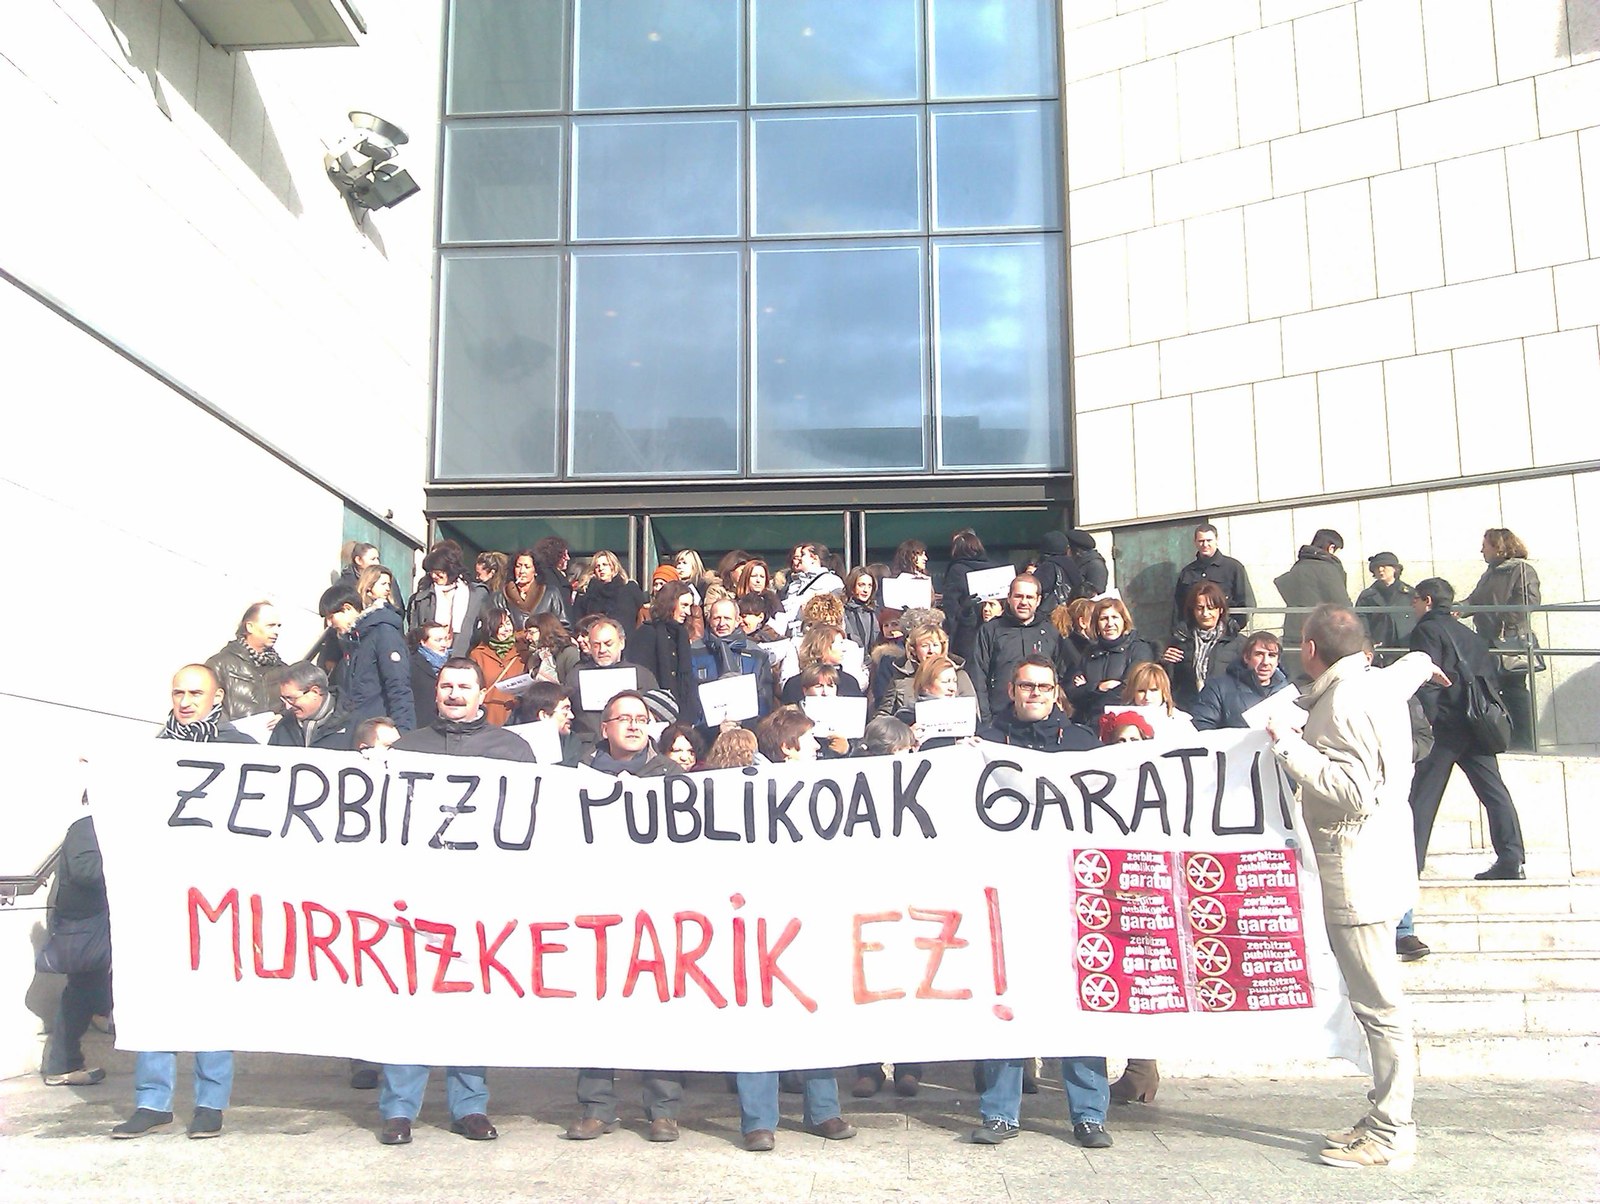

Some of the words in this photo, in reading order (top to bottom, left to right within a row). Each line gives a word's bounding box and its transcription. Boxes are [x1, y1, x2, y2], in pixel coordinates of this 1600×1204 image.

[168, 760, 542, 851] ZERBITZU
[579, 759, 939, 845] PUBLIKOAK
[1119, 873, 1172, 890] garatu
[1235, 871, 1297, 891] garatu
[1120, 914, 1175, 931] garatu
[1237, 916, 1299, 934] garatu
[853, 886, 1013, 1021] EZ!
[1122, 956, 1178, 974] garatu
[1241, 958, 1303, 977] garatu
[1129, 994, 1185, 1012] garatu
[1247, 991, 1308, 1010] garatu
